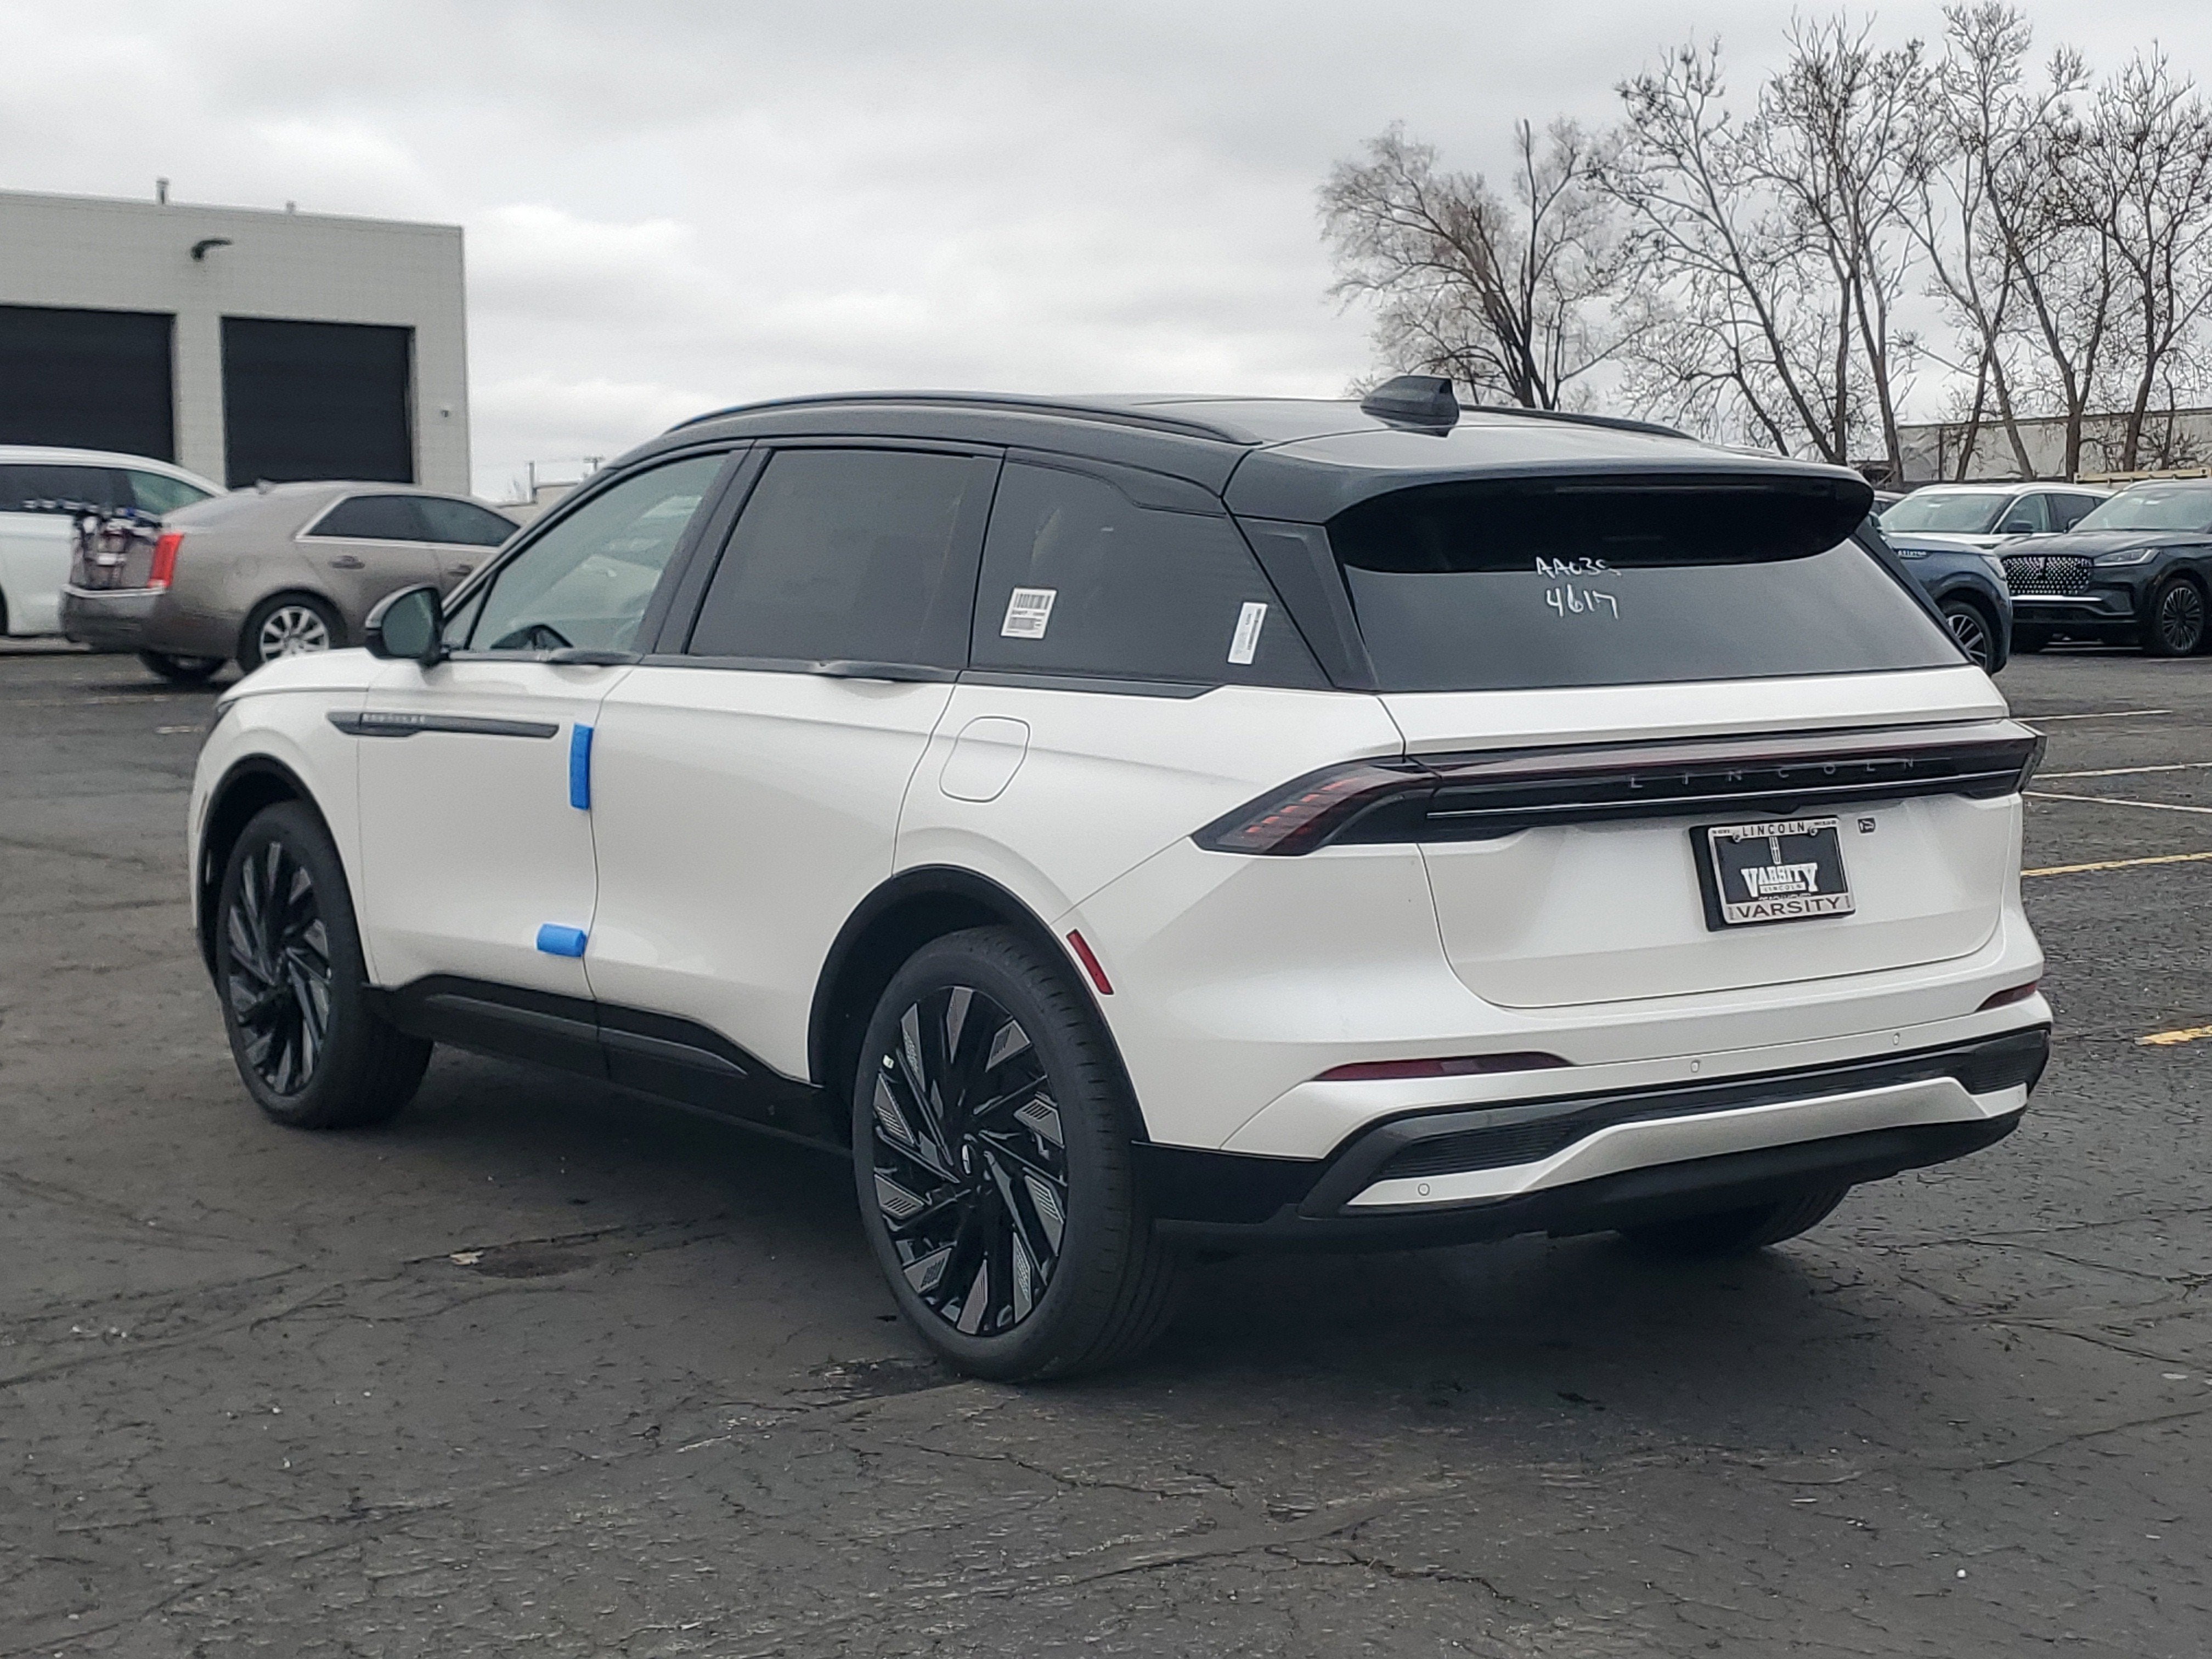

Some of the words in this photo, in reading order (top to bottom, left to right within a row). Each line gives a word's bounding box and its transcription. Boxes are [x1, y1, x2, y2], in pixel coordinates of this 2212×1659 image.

[1546, 583, 1618, 619] 4617
[1630, 759, 1914, 787] LINCOLN
[1742, 822, 1805, 837] LINCOLN
[1741, 862, 1819, 897] VARSITY
[1736, 898, 1840, 918] VARSITY
